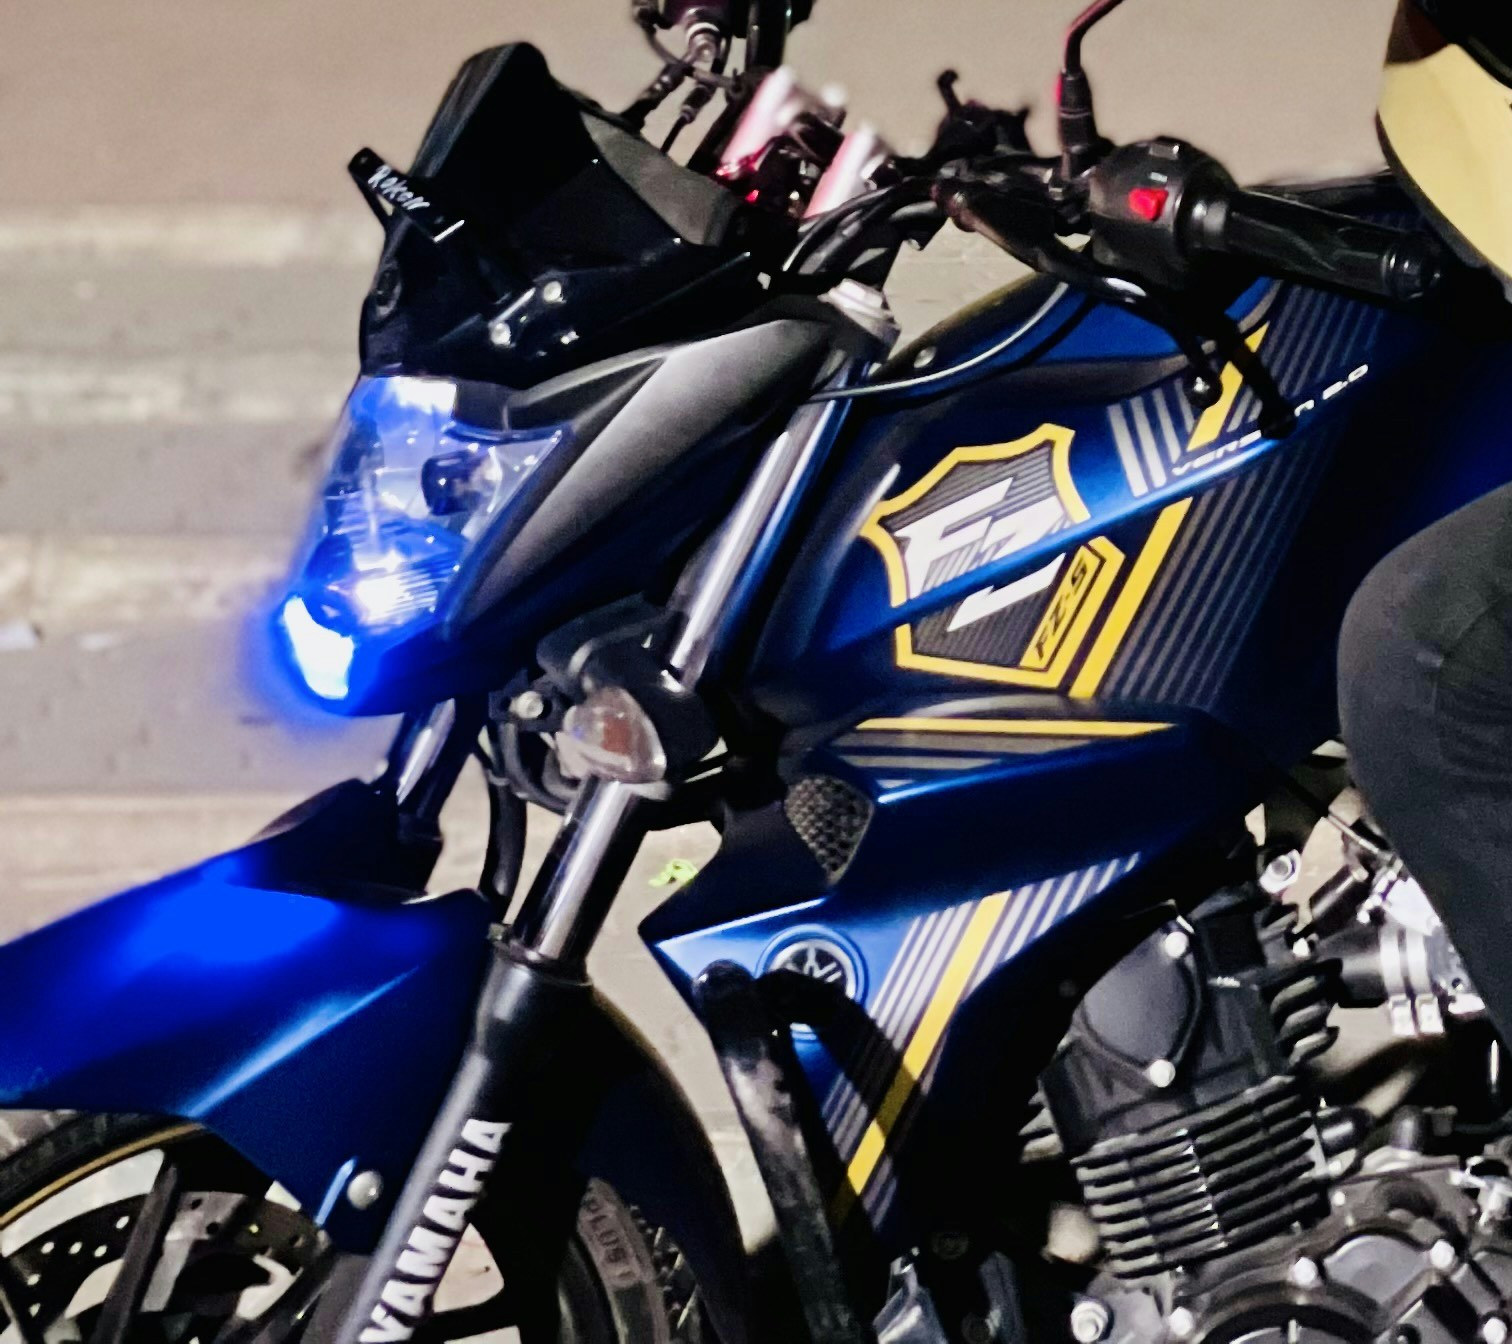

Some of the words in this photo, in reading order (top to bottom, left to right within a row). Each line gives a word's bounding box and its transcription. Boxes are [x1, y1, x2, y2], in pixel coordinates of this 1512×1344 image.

[1171, 398, 1315, 477] VERSN
[1034, 557, 1088, 662] FZ-S
[358, 1117, 513, 1343] YAMAHA
